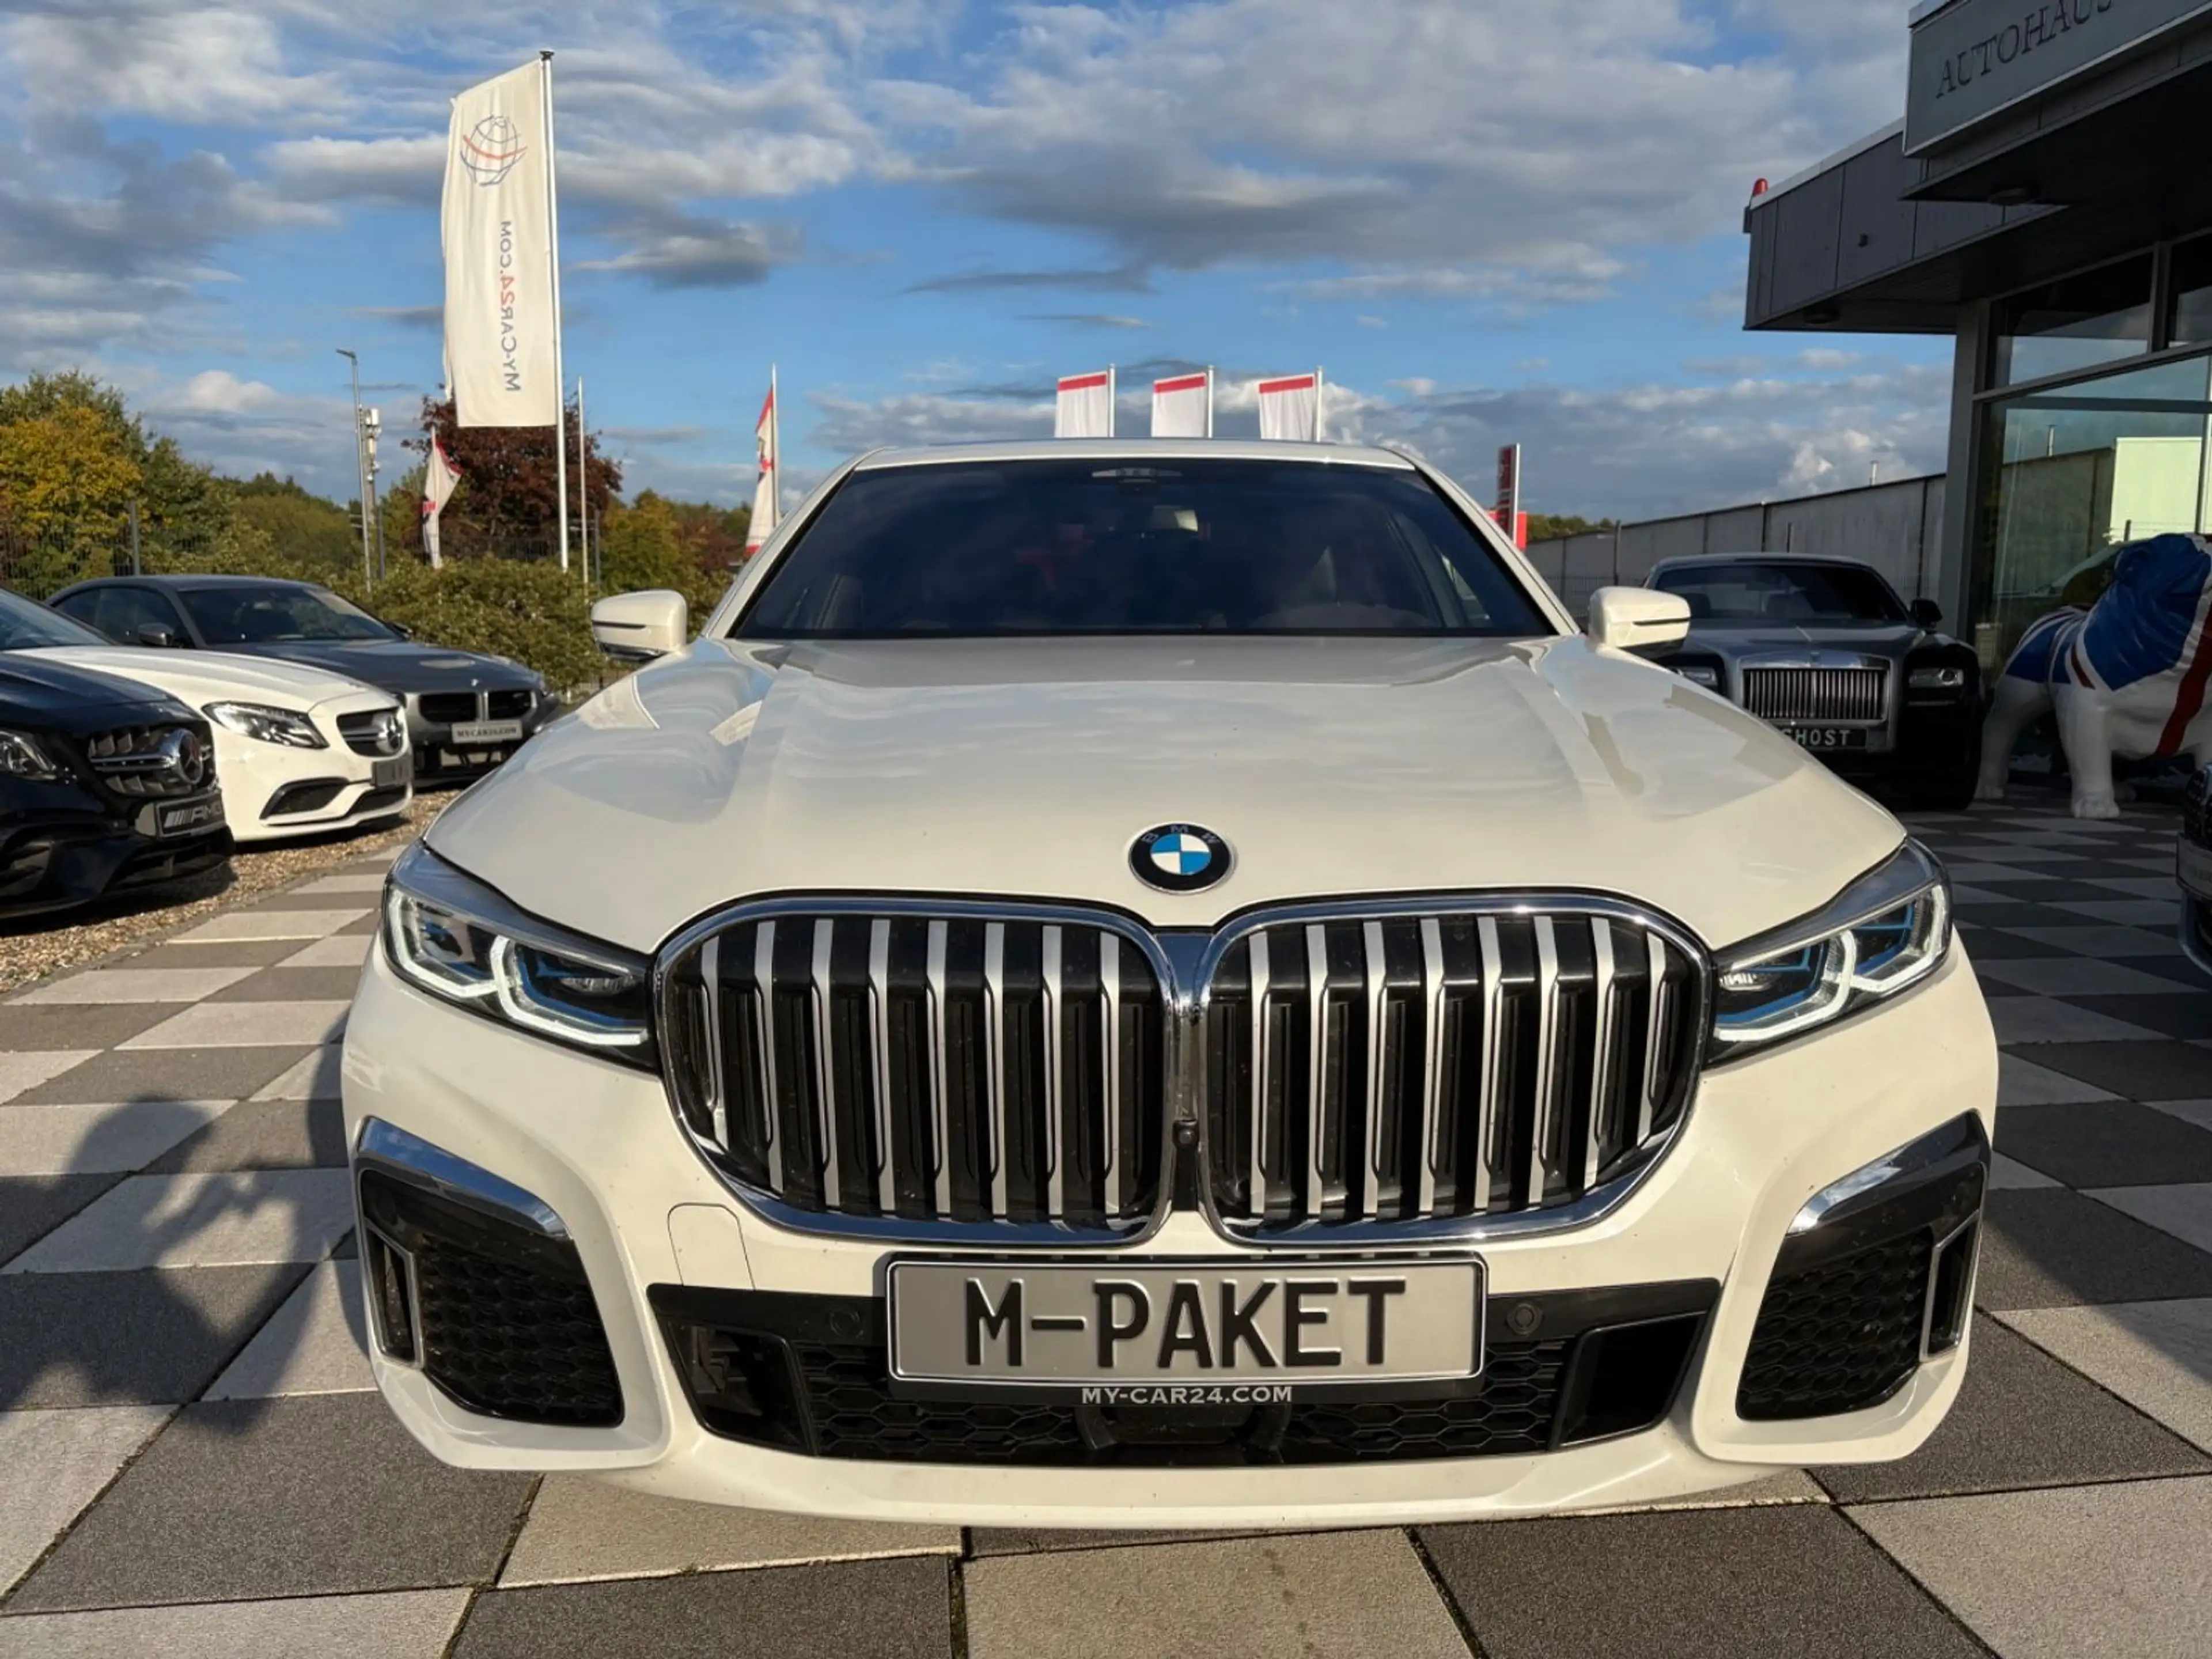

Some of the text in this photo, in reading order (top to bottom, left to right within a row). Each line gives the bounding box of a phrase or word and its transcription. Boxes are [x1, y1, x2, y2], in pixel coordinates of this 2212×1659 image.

[1141, 824, 1221, 844] BMW
[965, 1277, 1407, 1369] M-PAKET
[1082, 1386, 1292, 1404] MY-CAR24.COM
